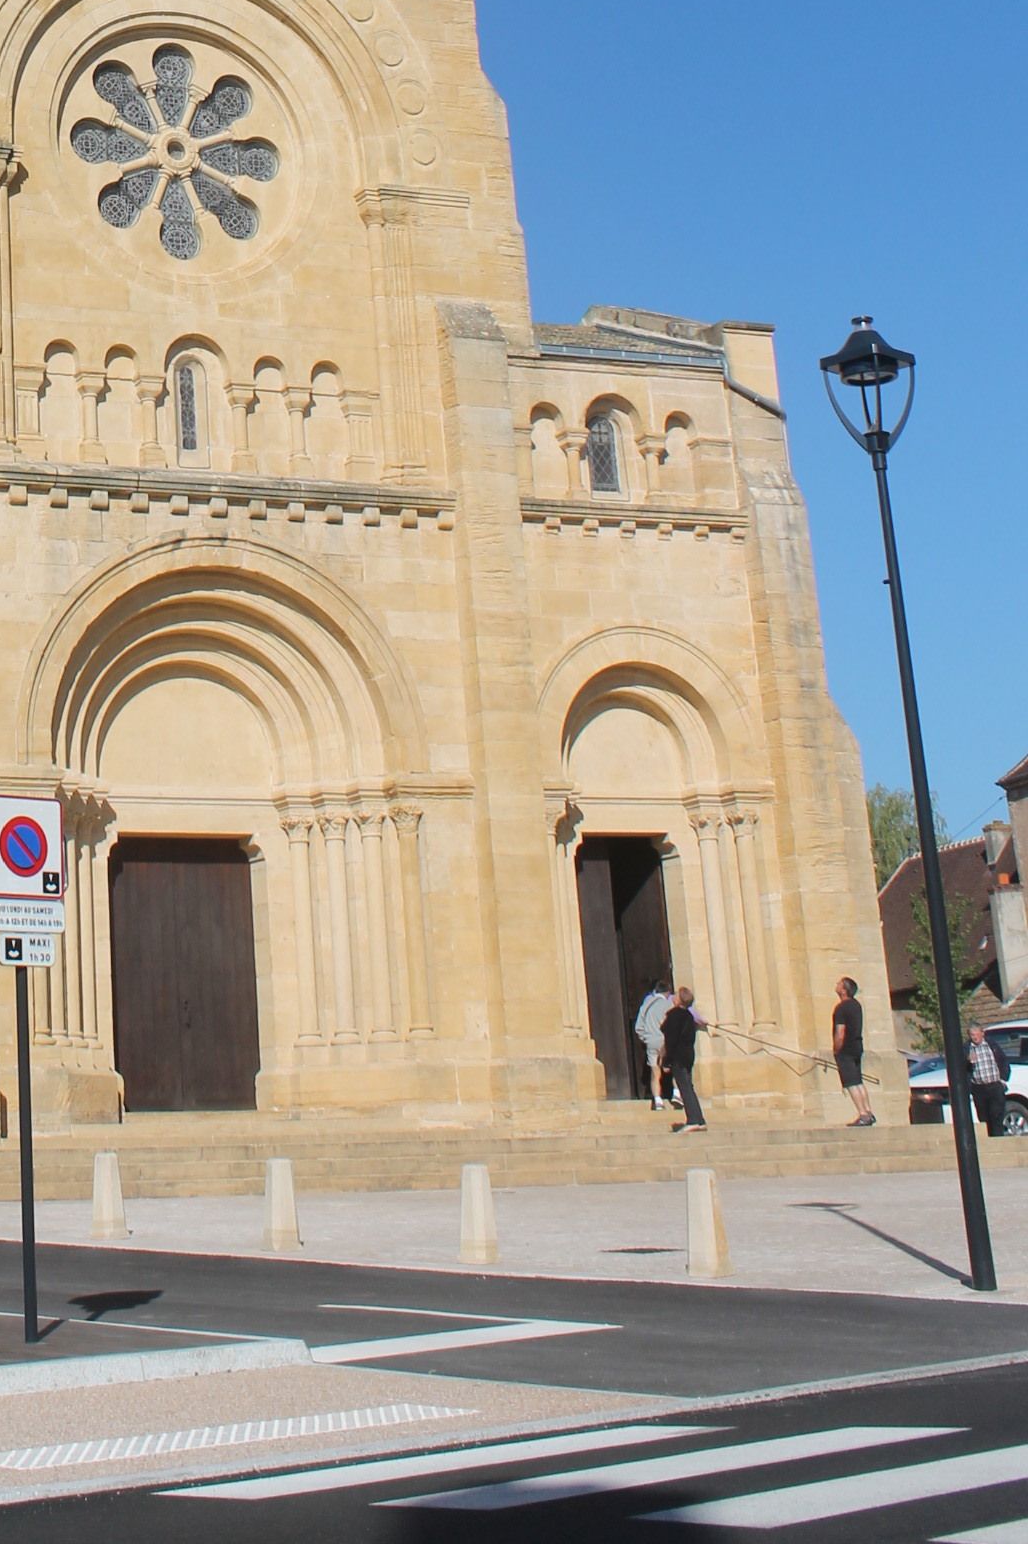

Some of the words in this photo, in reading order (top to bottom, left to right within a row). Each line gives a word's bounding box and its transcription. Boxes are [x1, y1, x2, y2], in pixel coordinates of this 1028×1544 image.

[6, 905, 22, 913] LUNDI
[32, 906, 54, 914] SAMEDI
[30, 938, 50, 947] MAXI
